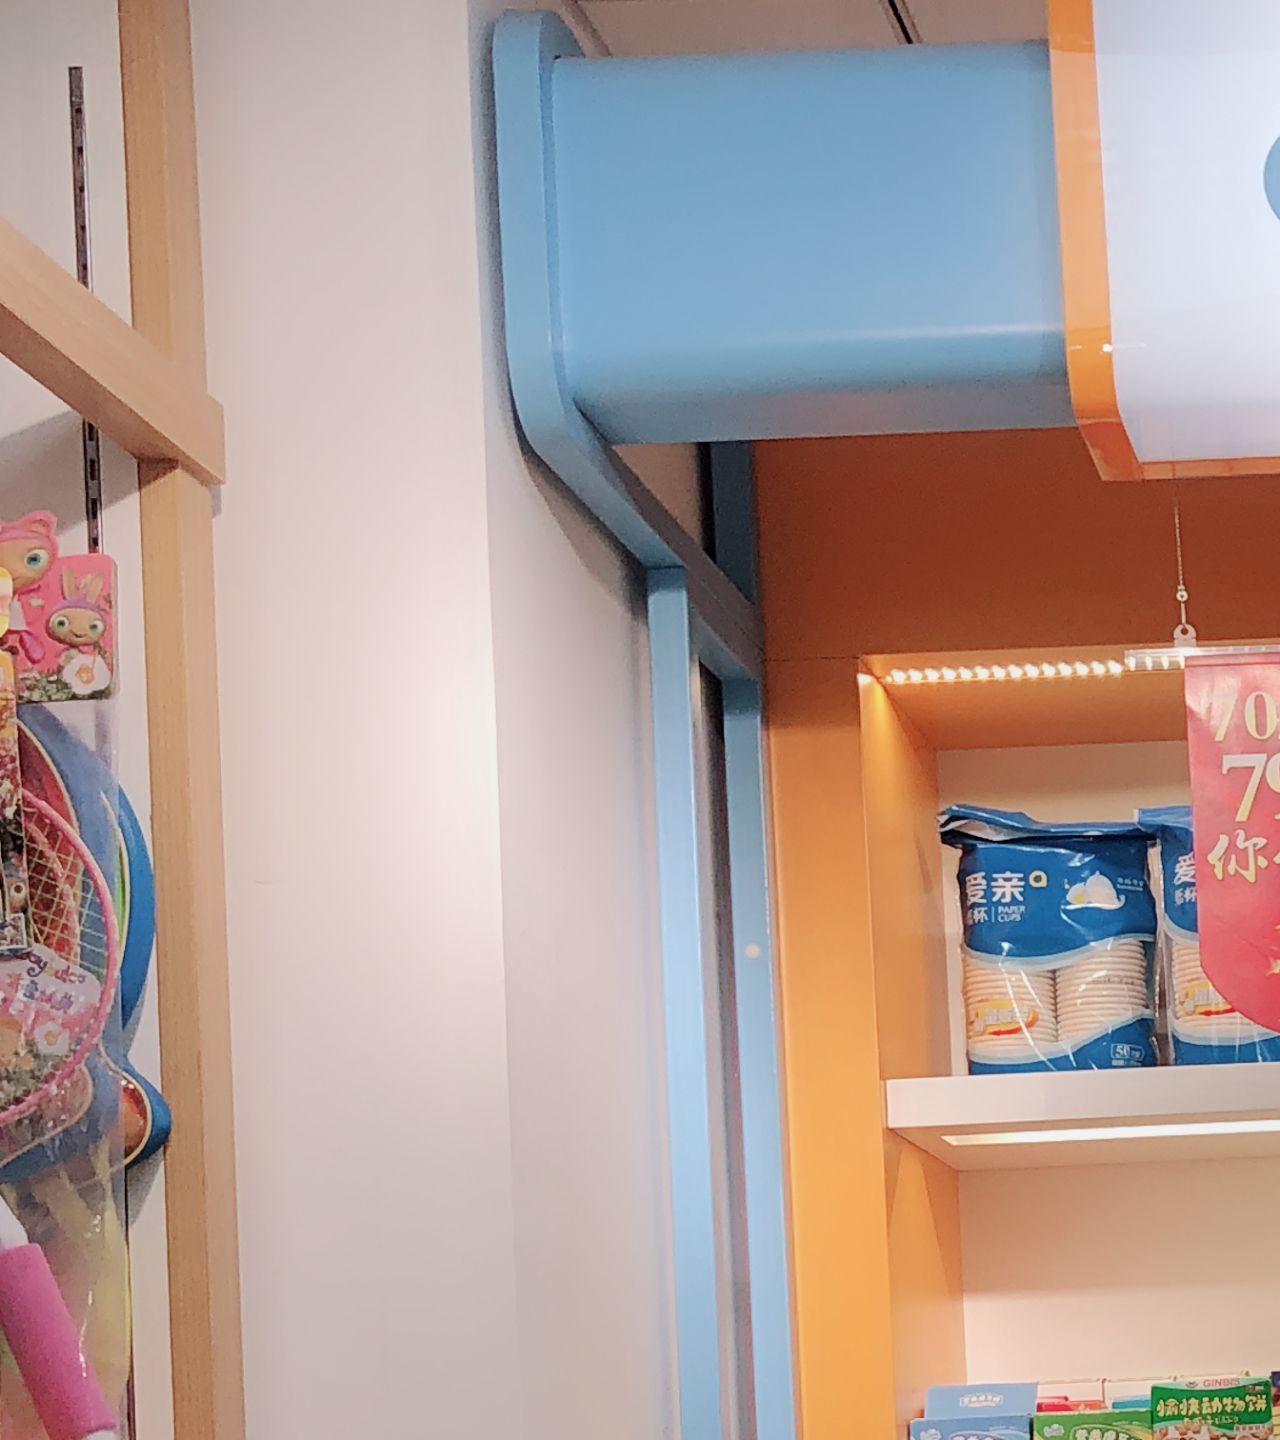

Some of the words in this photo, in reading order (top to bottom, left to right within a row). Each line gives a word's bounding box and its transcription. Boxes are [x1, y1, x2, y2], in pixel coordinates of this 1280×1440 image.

[1156, 1393, 1268, 1417] 愉快动物饼
